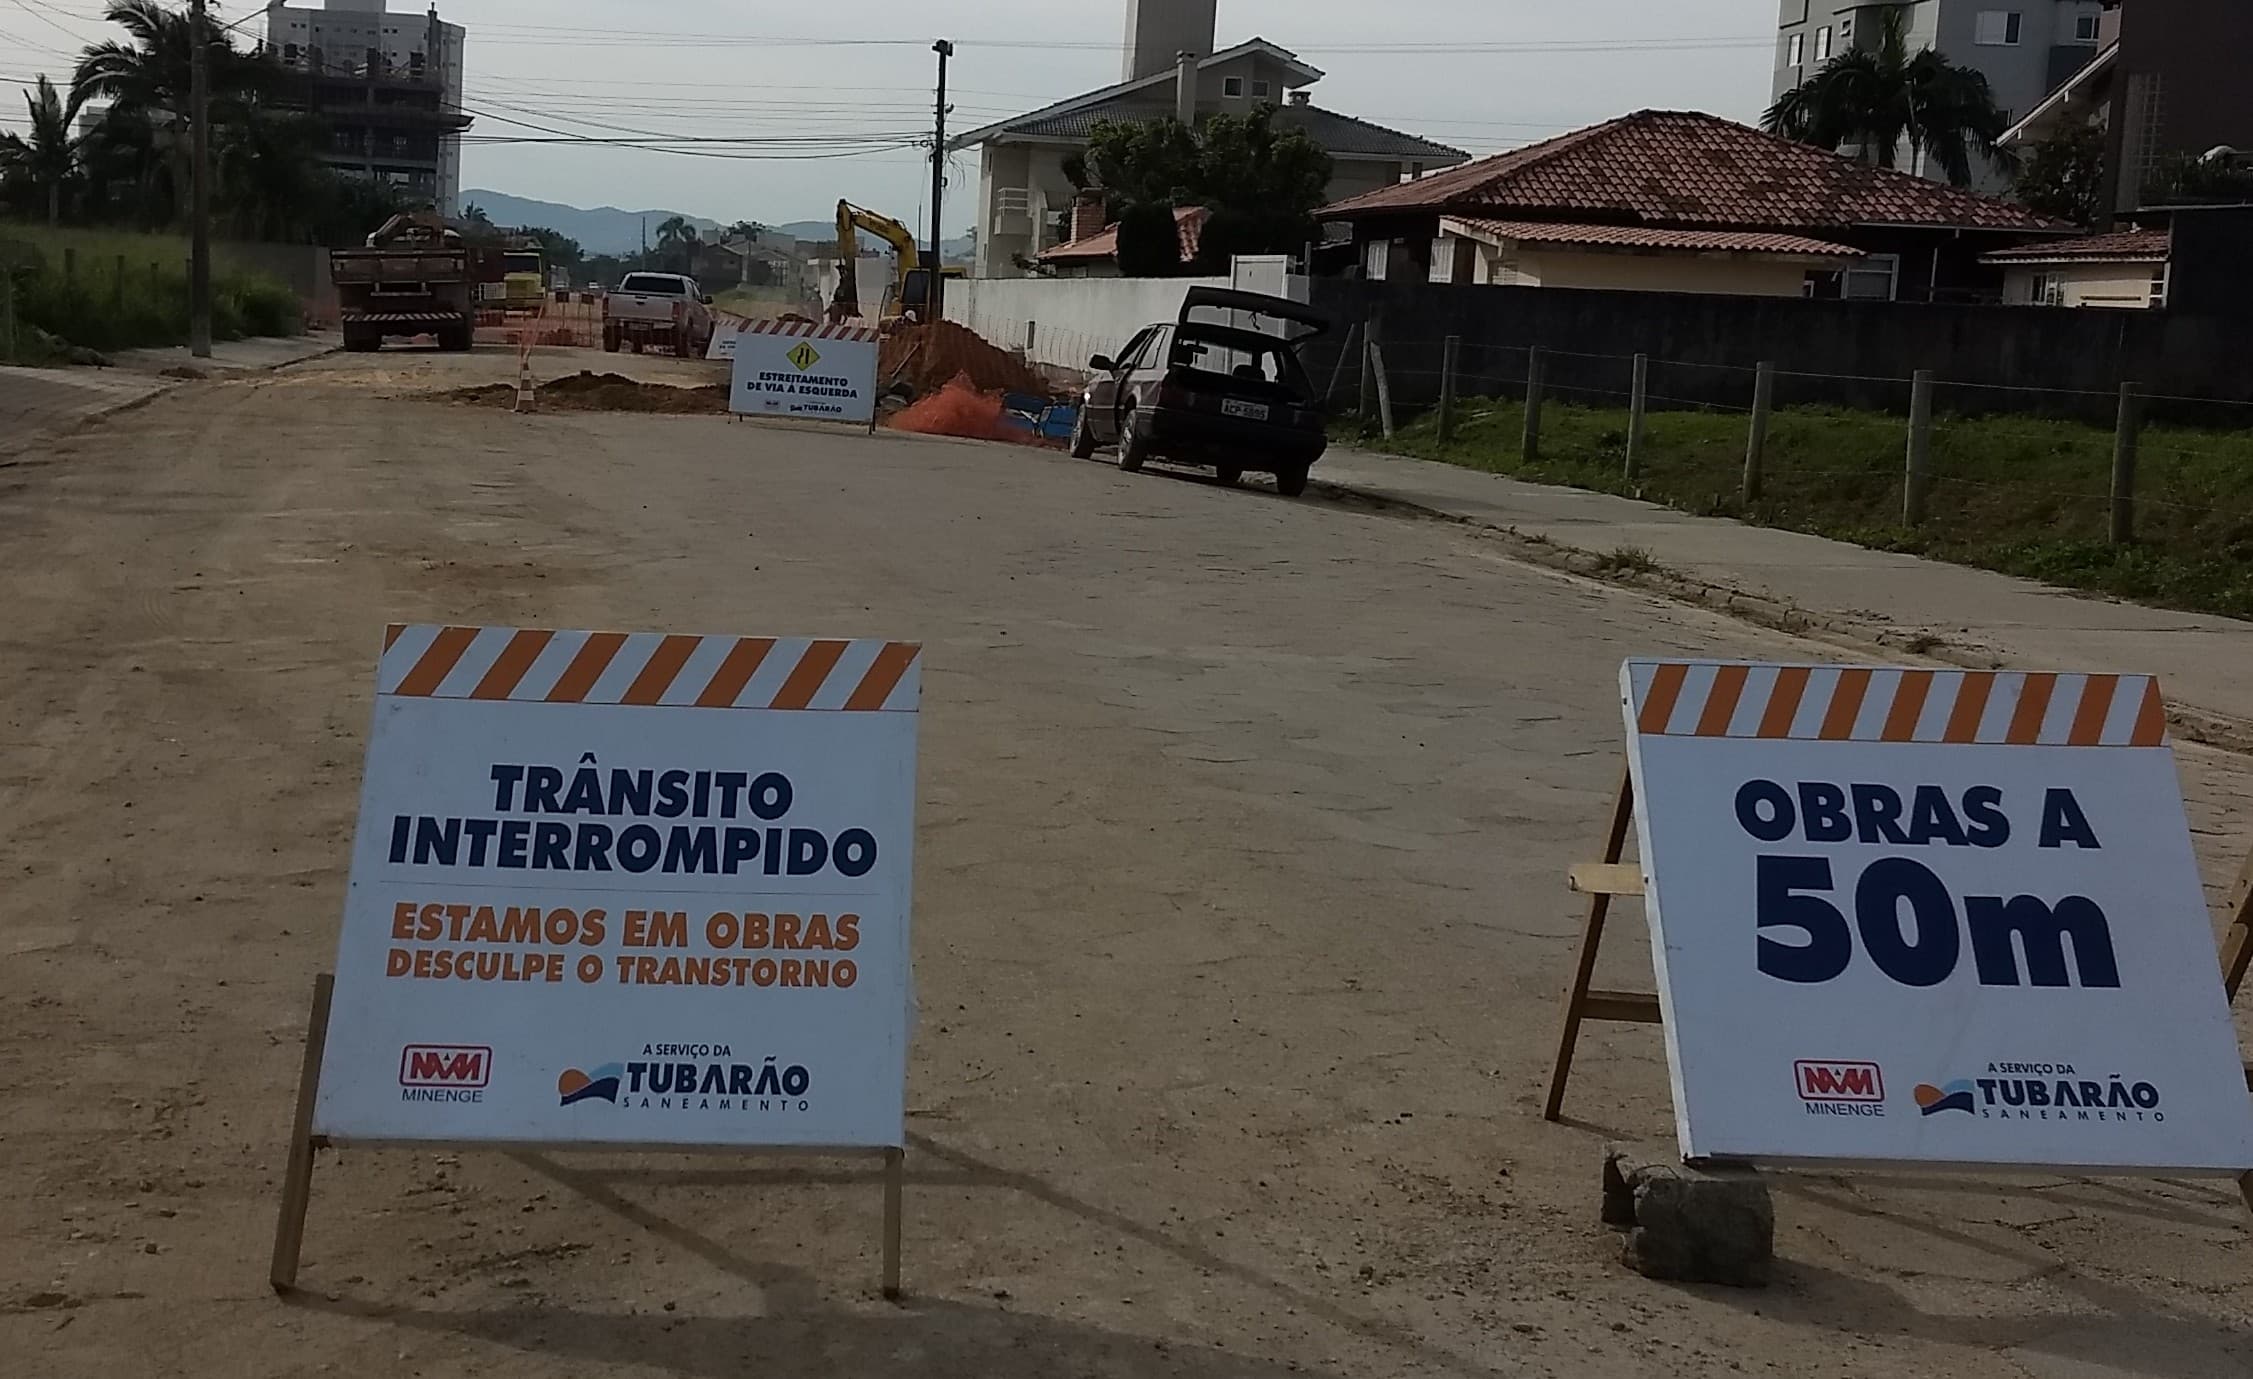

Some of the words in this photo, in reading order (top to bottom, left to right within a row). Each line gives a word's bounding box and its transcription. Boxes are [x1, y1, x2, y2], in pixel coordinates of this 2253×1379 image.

[747, 382, 762, 391] DE
[764, 382, 785, 393] VIA
[799, 386, 858, 399] ESQUERDA
[759, 372, 848, 387] ESTREITAMENTO
[489, 752, 793, 821] TRÂNSITO
[1734, 779, 2011, 848] OBRAS
[2037, 787, 2102, 849] A
[388, 816, 878, 877] INTERROMPIDO
[392, 902, 607, 946] ESTAMOS
[622, 910, 689, 948] EM
[705, 912, 860, 952] OBRAS
[1756, 854, 2121, 988] 50m
[386, 949, 565, 982] DESCULPE
[576, 954, 604, 984] O
[616, 956, 858, 988] TRANSTORNO
[642, 1043, 653, 1056] A
[655, 1043, 710, 1059] SERVIÇO
[713, 1044, 731, 1057] DA
[626, 1055, 810, 1097] TUBARÃO
[1987, 1062, 1998, 1073] A
[1999, 1062, 2054, 1076] SERVIÇO
[2056, 1063, 2076, 1075] DA
[402, 1088, 484, 1104] MINENGE
[1976, 1073, 2160, 1109] TUBARÃO
[623, 1097, 810, 1112] SANEAMENTO
[1805, 1102, 1886, 1118] MINENGE
[1981, 1107, 2165, 1122] SANEAMENTO
